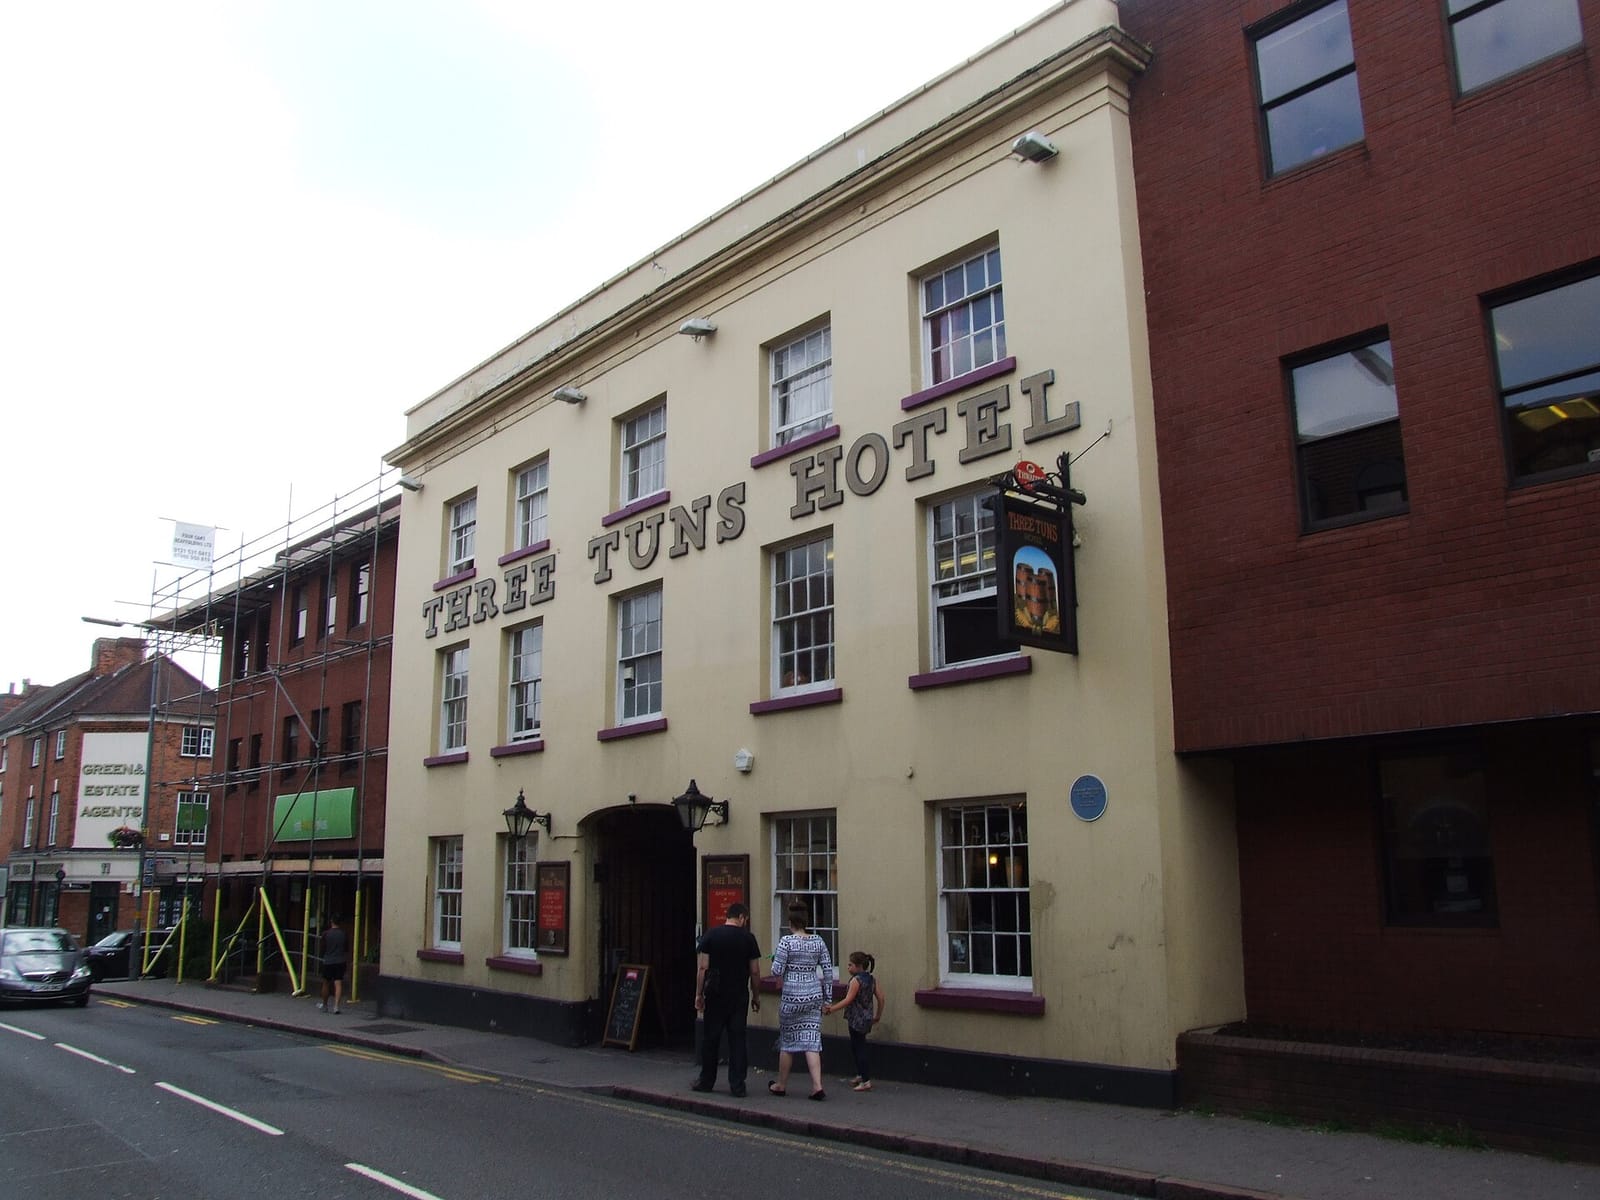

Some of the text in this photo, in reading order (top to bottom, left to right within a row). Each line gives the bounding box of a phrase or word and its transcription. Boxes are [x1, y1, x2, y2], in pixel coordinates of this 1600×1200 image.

[423, 369, 1082, 639] THREE TUNS HOTEL
[1008, 512, 1057, 542] THREE TUNS
[83, 785, 140, 797] ESTATE
[80, 806, 142, 818] AGENTS
